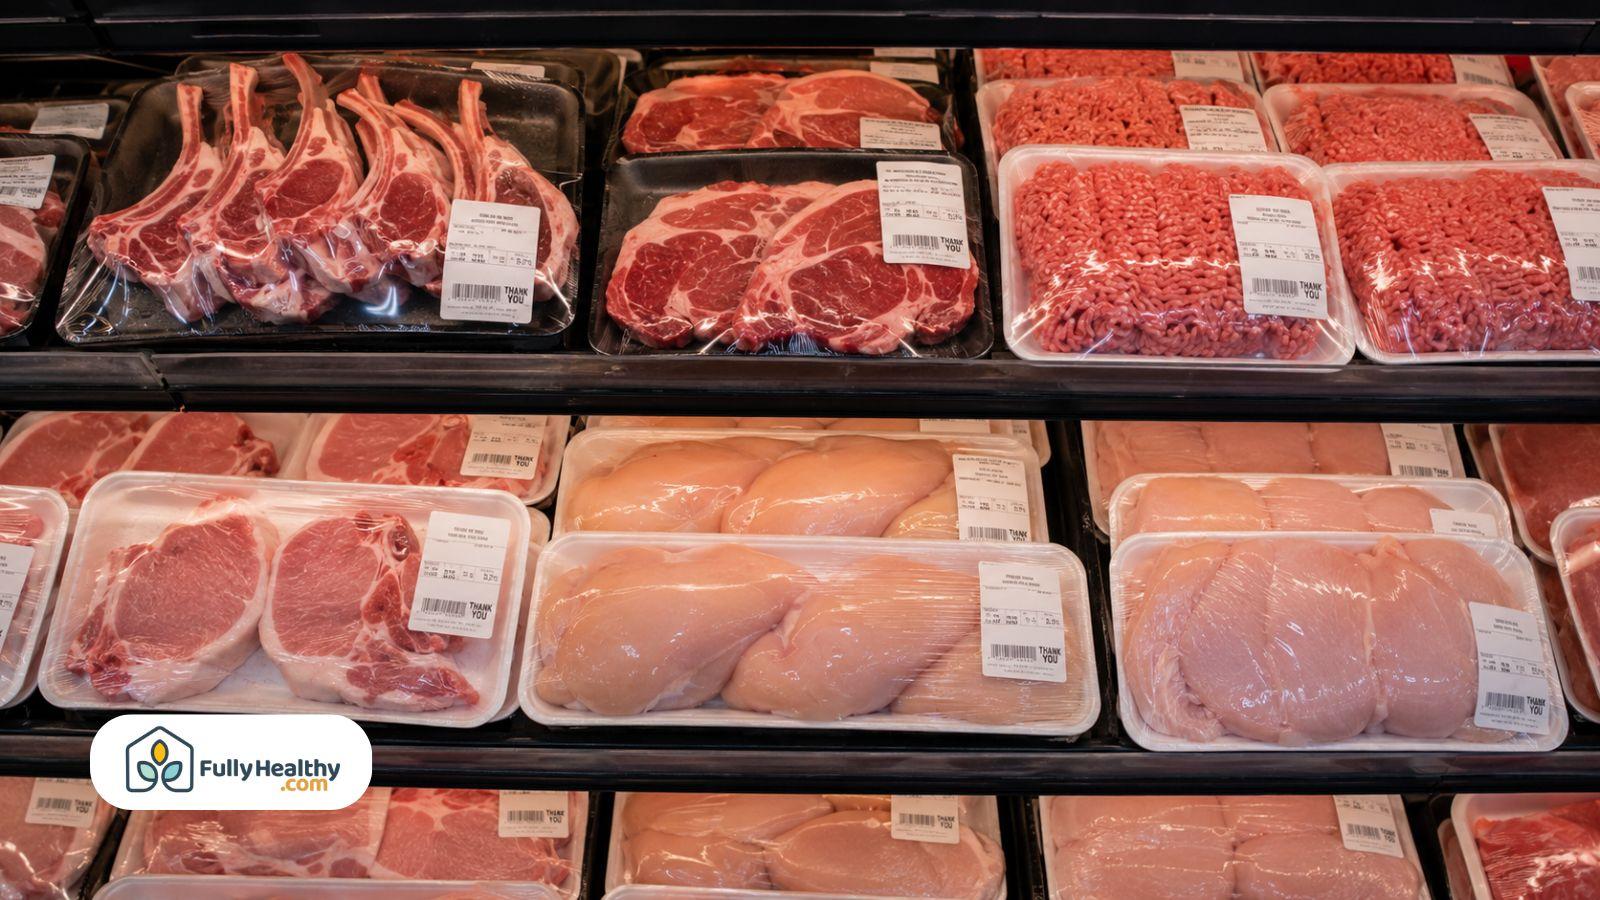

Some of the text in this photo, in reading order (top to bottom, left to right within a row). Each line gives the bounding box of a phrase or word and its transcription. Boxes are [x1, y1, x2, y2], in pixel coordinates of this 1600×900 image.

[941, 236, 963, 247] THANK
[945, 243, 961, 253] YOU
[504, 286, 528, 296] THANK
[1299, 281, 1322, 291] THANK
[507, 294, 524, 304] YOU
[1303, 289, 1319, 300] YOU
[469, 602, 493, 612] THANK
[472, 610, 487, 620] YOU
[1039, 646, 1061, 656] THANK
[1042, 653, 1058, 664] YOU
[1526, 696, 1546, 707] THANK
[1530, 705, 1543, 716] YOU
